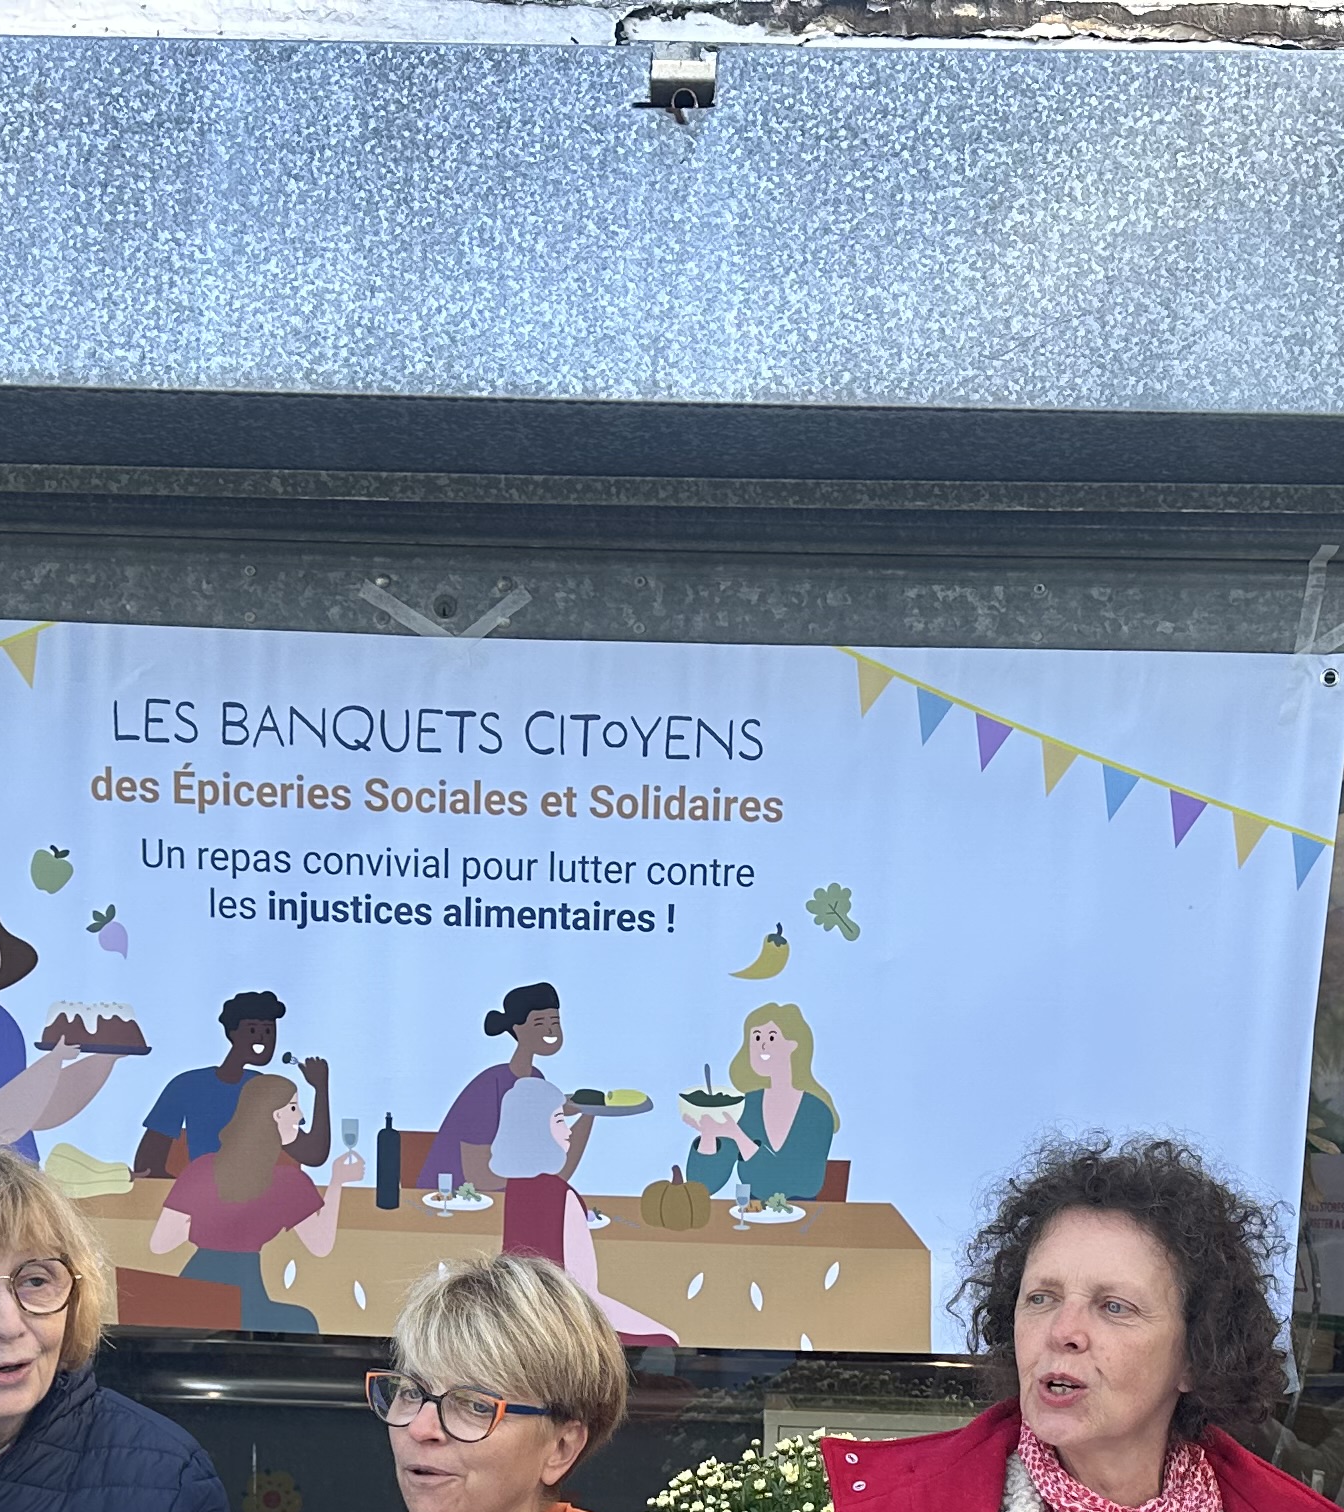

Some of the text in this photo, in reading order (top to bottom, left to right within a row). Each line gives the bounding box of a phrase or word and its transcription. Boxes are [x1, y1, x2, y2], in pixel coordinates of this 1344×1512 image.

[113, 698, 764, 761] LES BANQUETS CITOYENS
[90, 763, 784, 823] des Épiceries Sociales et Solidaires
[141, 838, 755, 888] Un repas convivial pour lutter contre
[210, 887, 676, 933] les injustices alimentaires !
